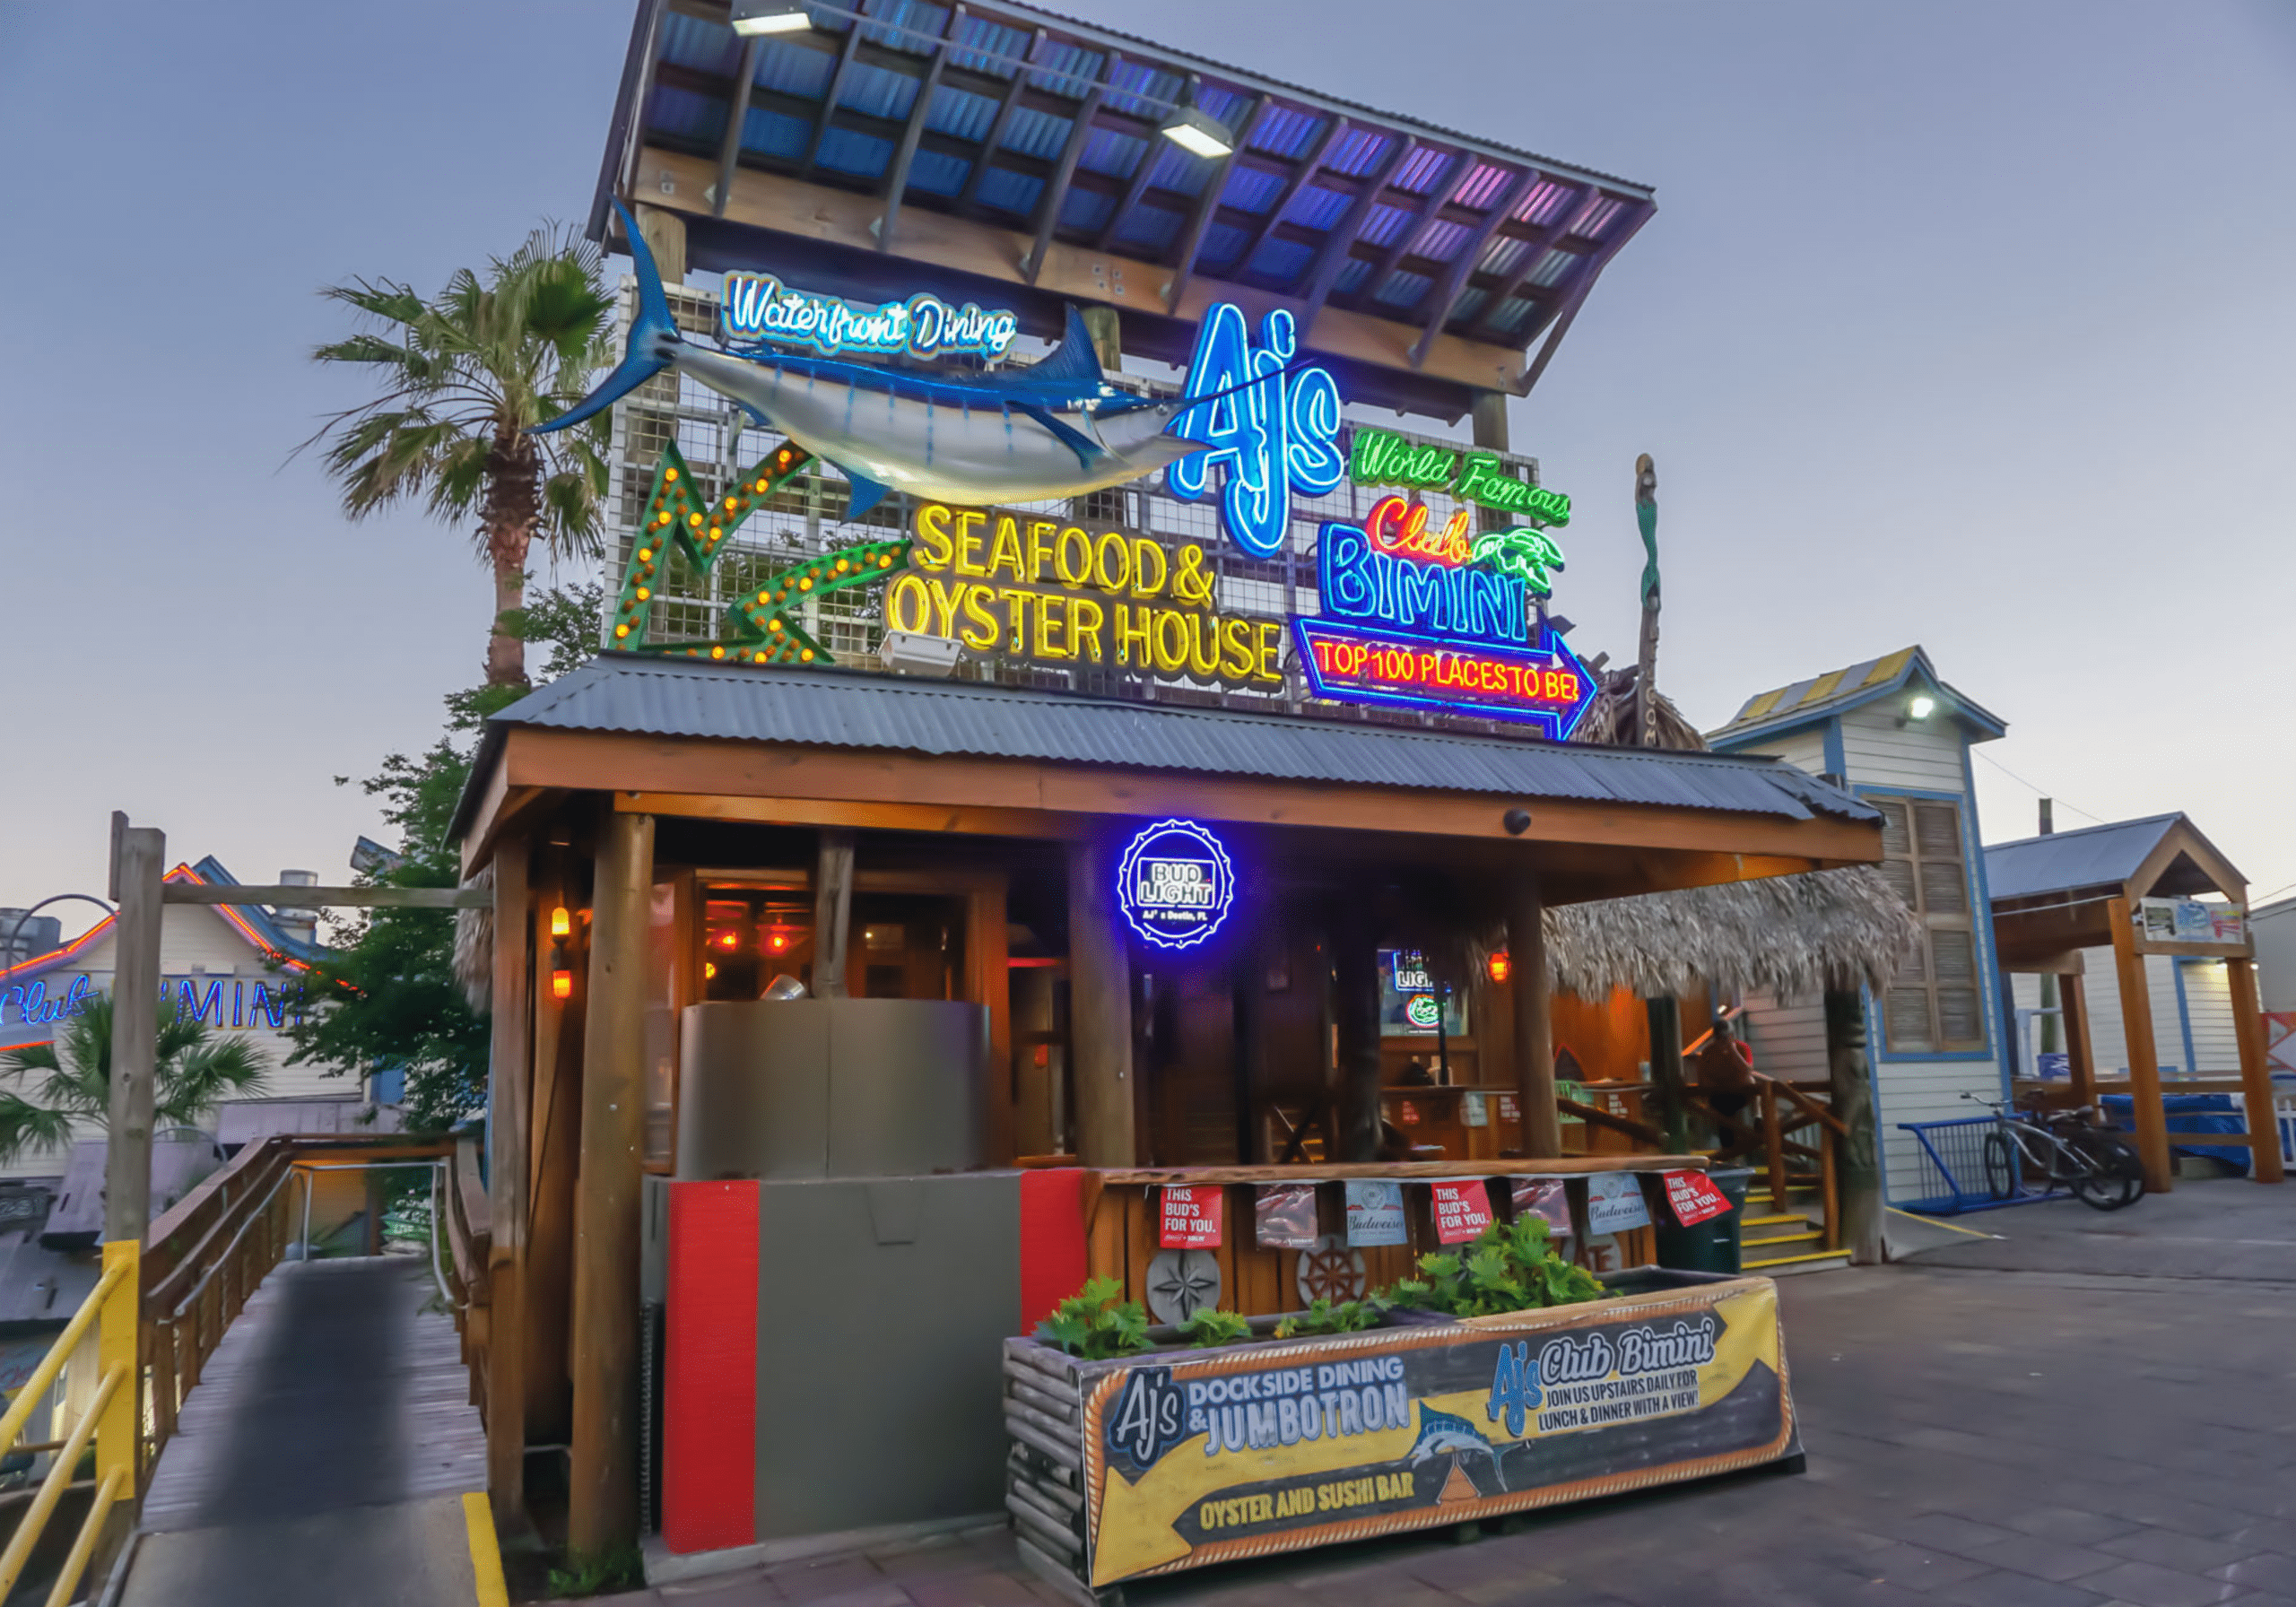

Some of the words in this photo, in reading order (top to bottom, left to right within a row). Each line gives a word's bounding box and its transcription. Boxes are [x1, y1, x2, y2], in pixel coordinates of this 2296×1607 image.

[728, 274, 907, 348] Waterfront
[912, 297, 1017, 352] Dining
[1359, 431, 1456, 483] World
[1458, 457, 1570, 519] Famous
[1371, 496, 1472, 565] Club
[915, 503, 1167, 599] SEAFOOD
[1172, 543, 1214, 605] &
[1323, 522, 1527, 642] BIMINI
[887, 574, 1104, 664] OYSTER
[1115, 604, 1282, 682] HOUSE
[1314, 640, 1368, 676] TOP
[1371, 649, 1414, 681] 100
[1422, 653, 1508, 691] PLACES
[1508, 665, 1539, 698] TO
[1152, 863, 1202, 883] BUD
[1141, 882, 1212, 905] LIGHT
[1167, 1188, 1192, 1201] THIS
[1436, 1187, 1459, 1201] THIS
[1667, 1177, 1687, 1190] THIS
[1670, 1187, 1700, 1203] BUD'S
[1675, 1201, 1698, 1214] FOR
[1694, 1193, 1721, 1208] YOU.
[1165, 1203, 1200, 1217] BUD'S
[1165, 1218, 1187, 1232] FOR
[1189, 1219, 1216, 1233] YOU.
[1438, 1201, 1471, 1215] BUD'S
[1440, 1215, 1463, 1229] FOR
[1463, 1212, 1490, 1226] YOU.
[1541, 1334, 1613, 1387] Club
[1618, 1317, 1715, 1376] Bimini
[1188, 1367, 1314, 1405] DOCKSIDE
[1318, 1356, 1405, 1388] DINING
[1546, 1389, 1573, 1409] JOIN
[1573, 1385, 1590, 1404] US
[1591, 1377, 1646, 1402] UPSTAIRS
[1647, 1373, 1675, 1394] DAILY
[1676, 1369, 1698, 1387] FOR
[1188, 1408, 1208, 1431] &
[1205, 1382, 1410, 1457] JUMBOTRON
[1538, 1411, 1578, 1431] LUNCH
[1579, 1407, 1589, 1425] &
[1590, 1402, 1631, 1424] DINNER
[1632, 1396, 1660, 1417] WITH
[1662, 1394, 1669, 1412] A
[1670, 1390, 1700, 1410] VIEW!
[1199, 1492, 1274, 1531] OYSTER
[1275, 1487, 1315, 1519] AND
[1318, 1476, 1375, 1512] SUSHI
[1378, 1471, 1414, 1502] BAR
